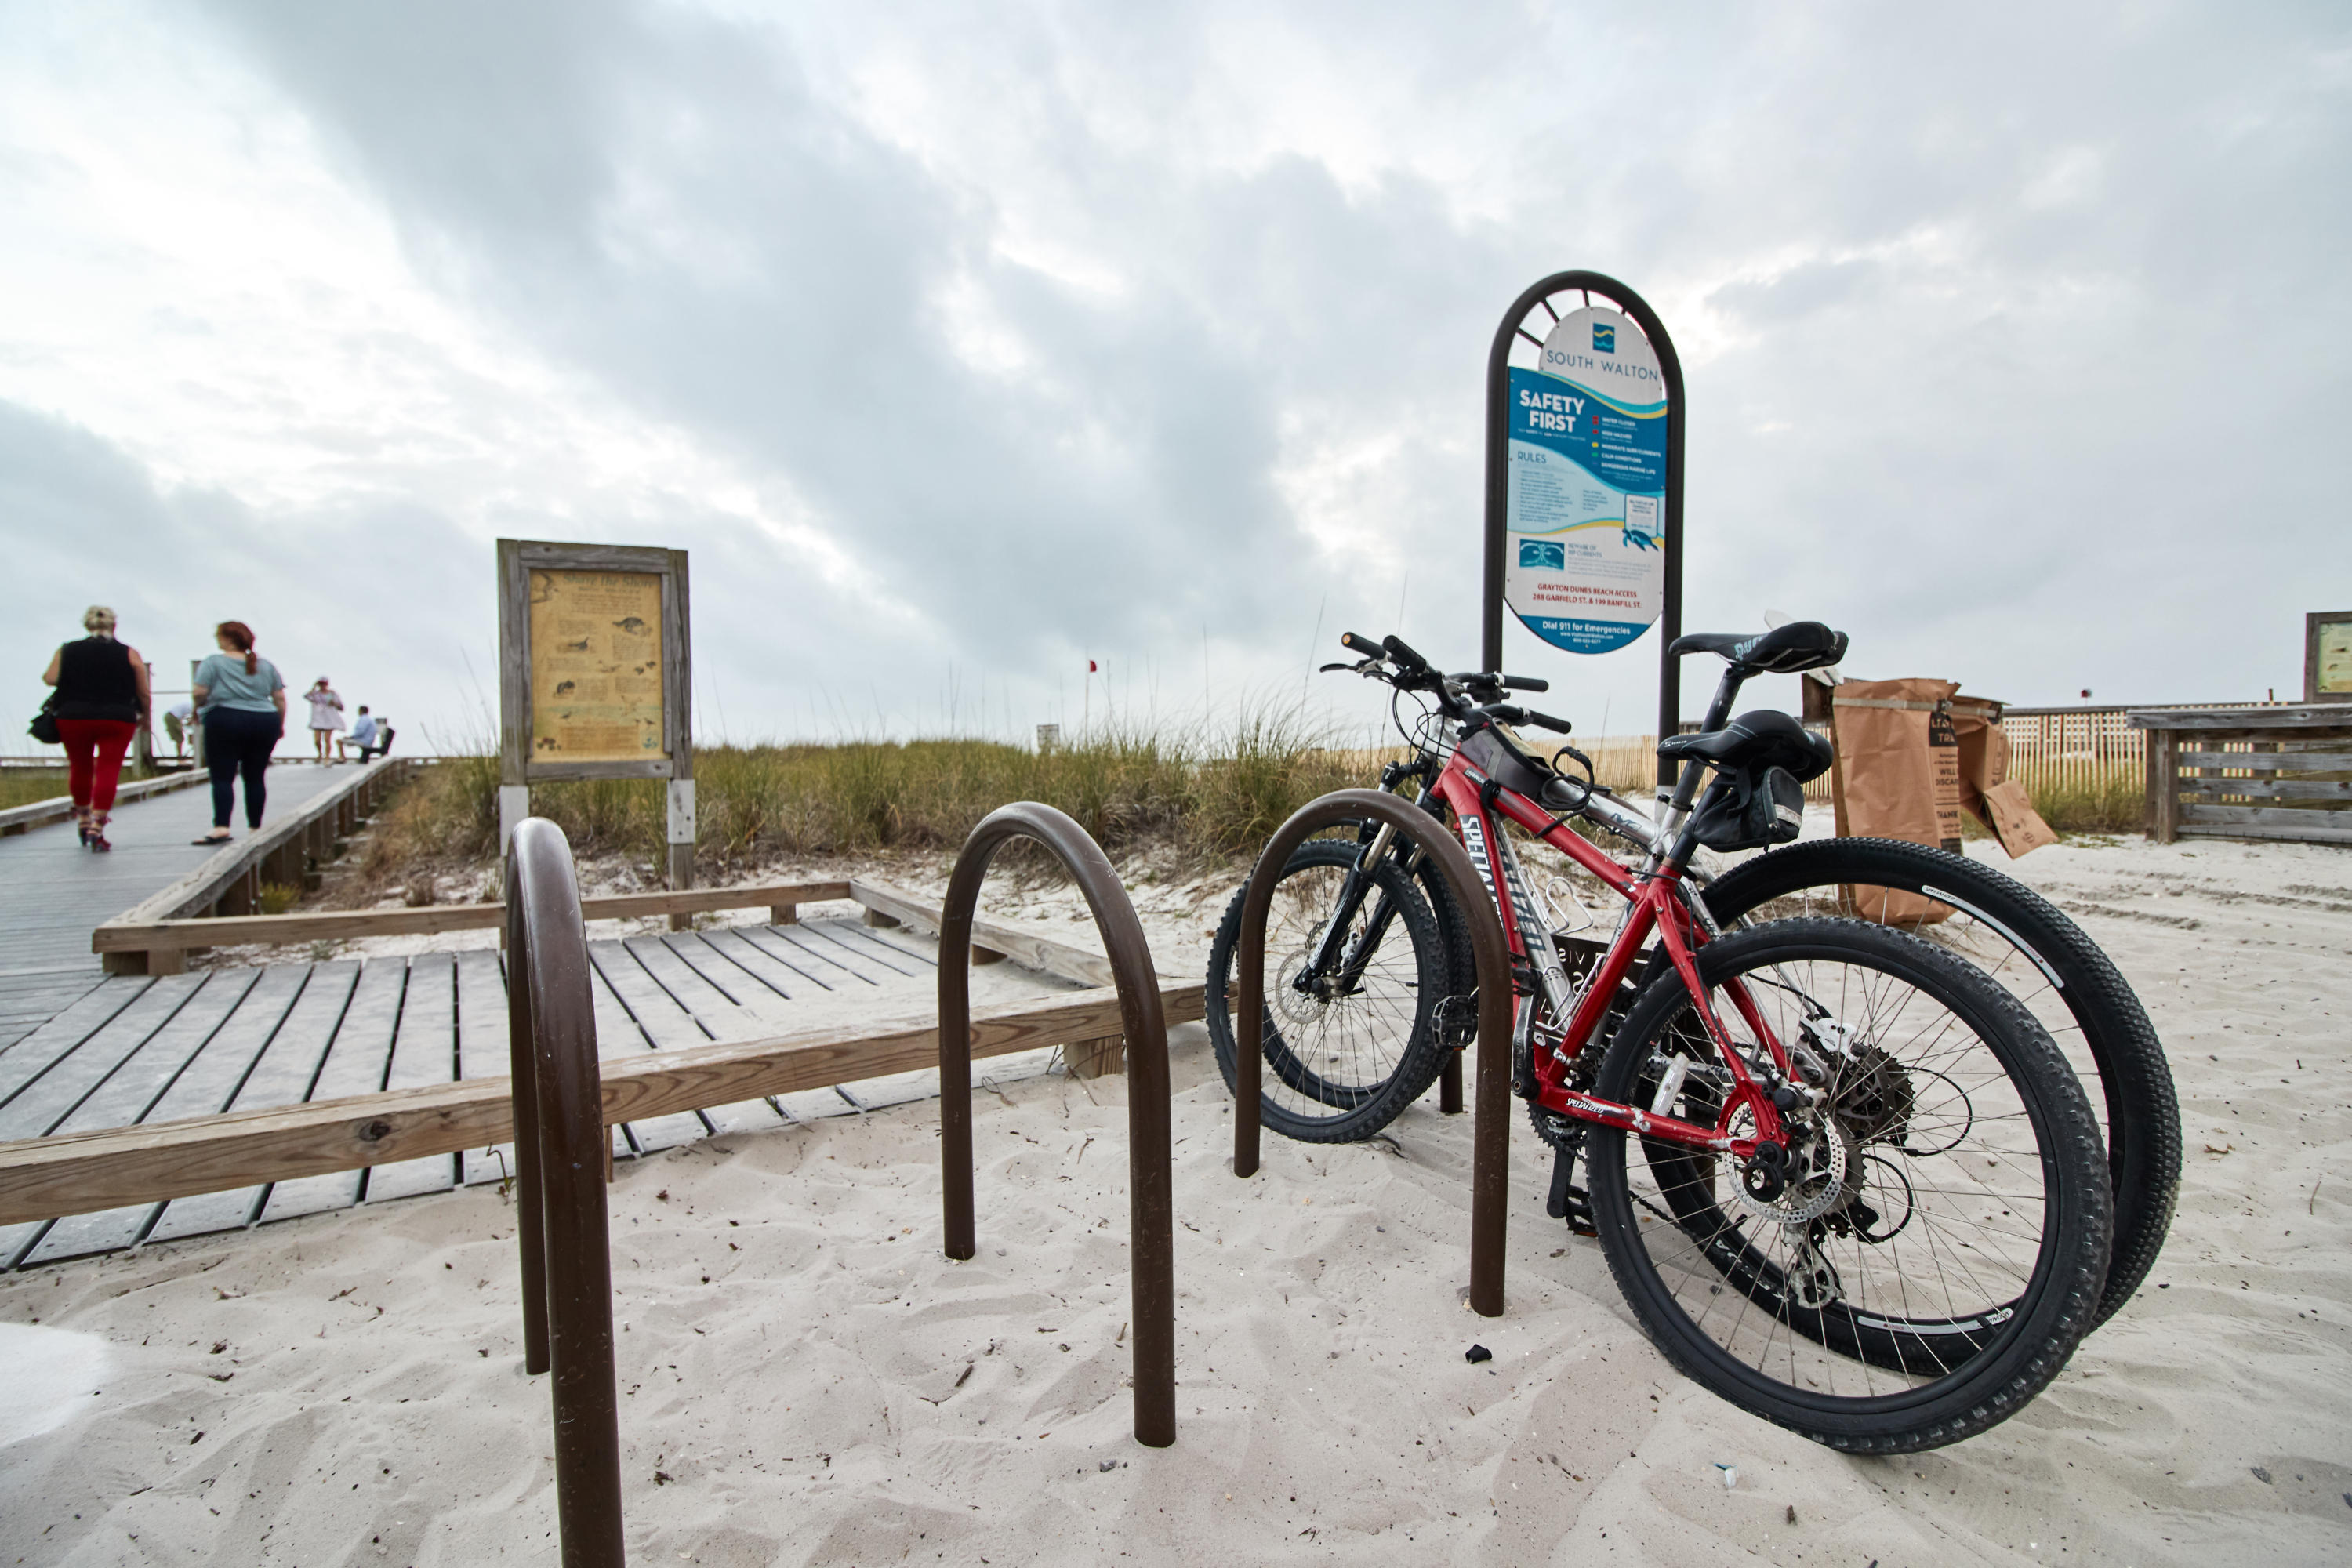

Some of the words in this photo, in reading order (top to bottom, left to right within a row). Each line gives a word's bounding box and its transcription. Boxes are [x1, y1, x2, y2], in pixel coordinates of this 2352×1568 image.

[1546, 350, 1594, 370] SOUTH
[1601, 360, 1659, 382] WALTON
[1519, 389, 1585, 415] SAFETY
[1529, 409, 1576, 433] FIRST
[1518, 451, 1547, 464] RULES
[1537, 583, 1569, 592] GRAYTON
[1570, 586, 1592, 594] DUNES
[1593, 587, 1613, 596] BEACH
[1614, 590, 1637, 598] ACCESS
[1545, 593, 1577, 603] GARFIELD
[1606, 599, 1632, 608] BANFILL
[1542, 620, 1557, 630] Dial
[1559, 622, 1570, 631] 911
[1572, 622, 1583, 632] for
[1584, 623, 1631, 635] Emergencies
[1566, 1098, 1604, 1114] SPECIALIZED
